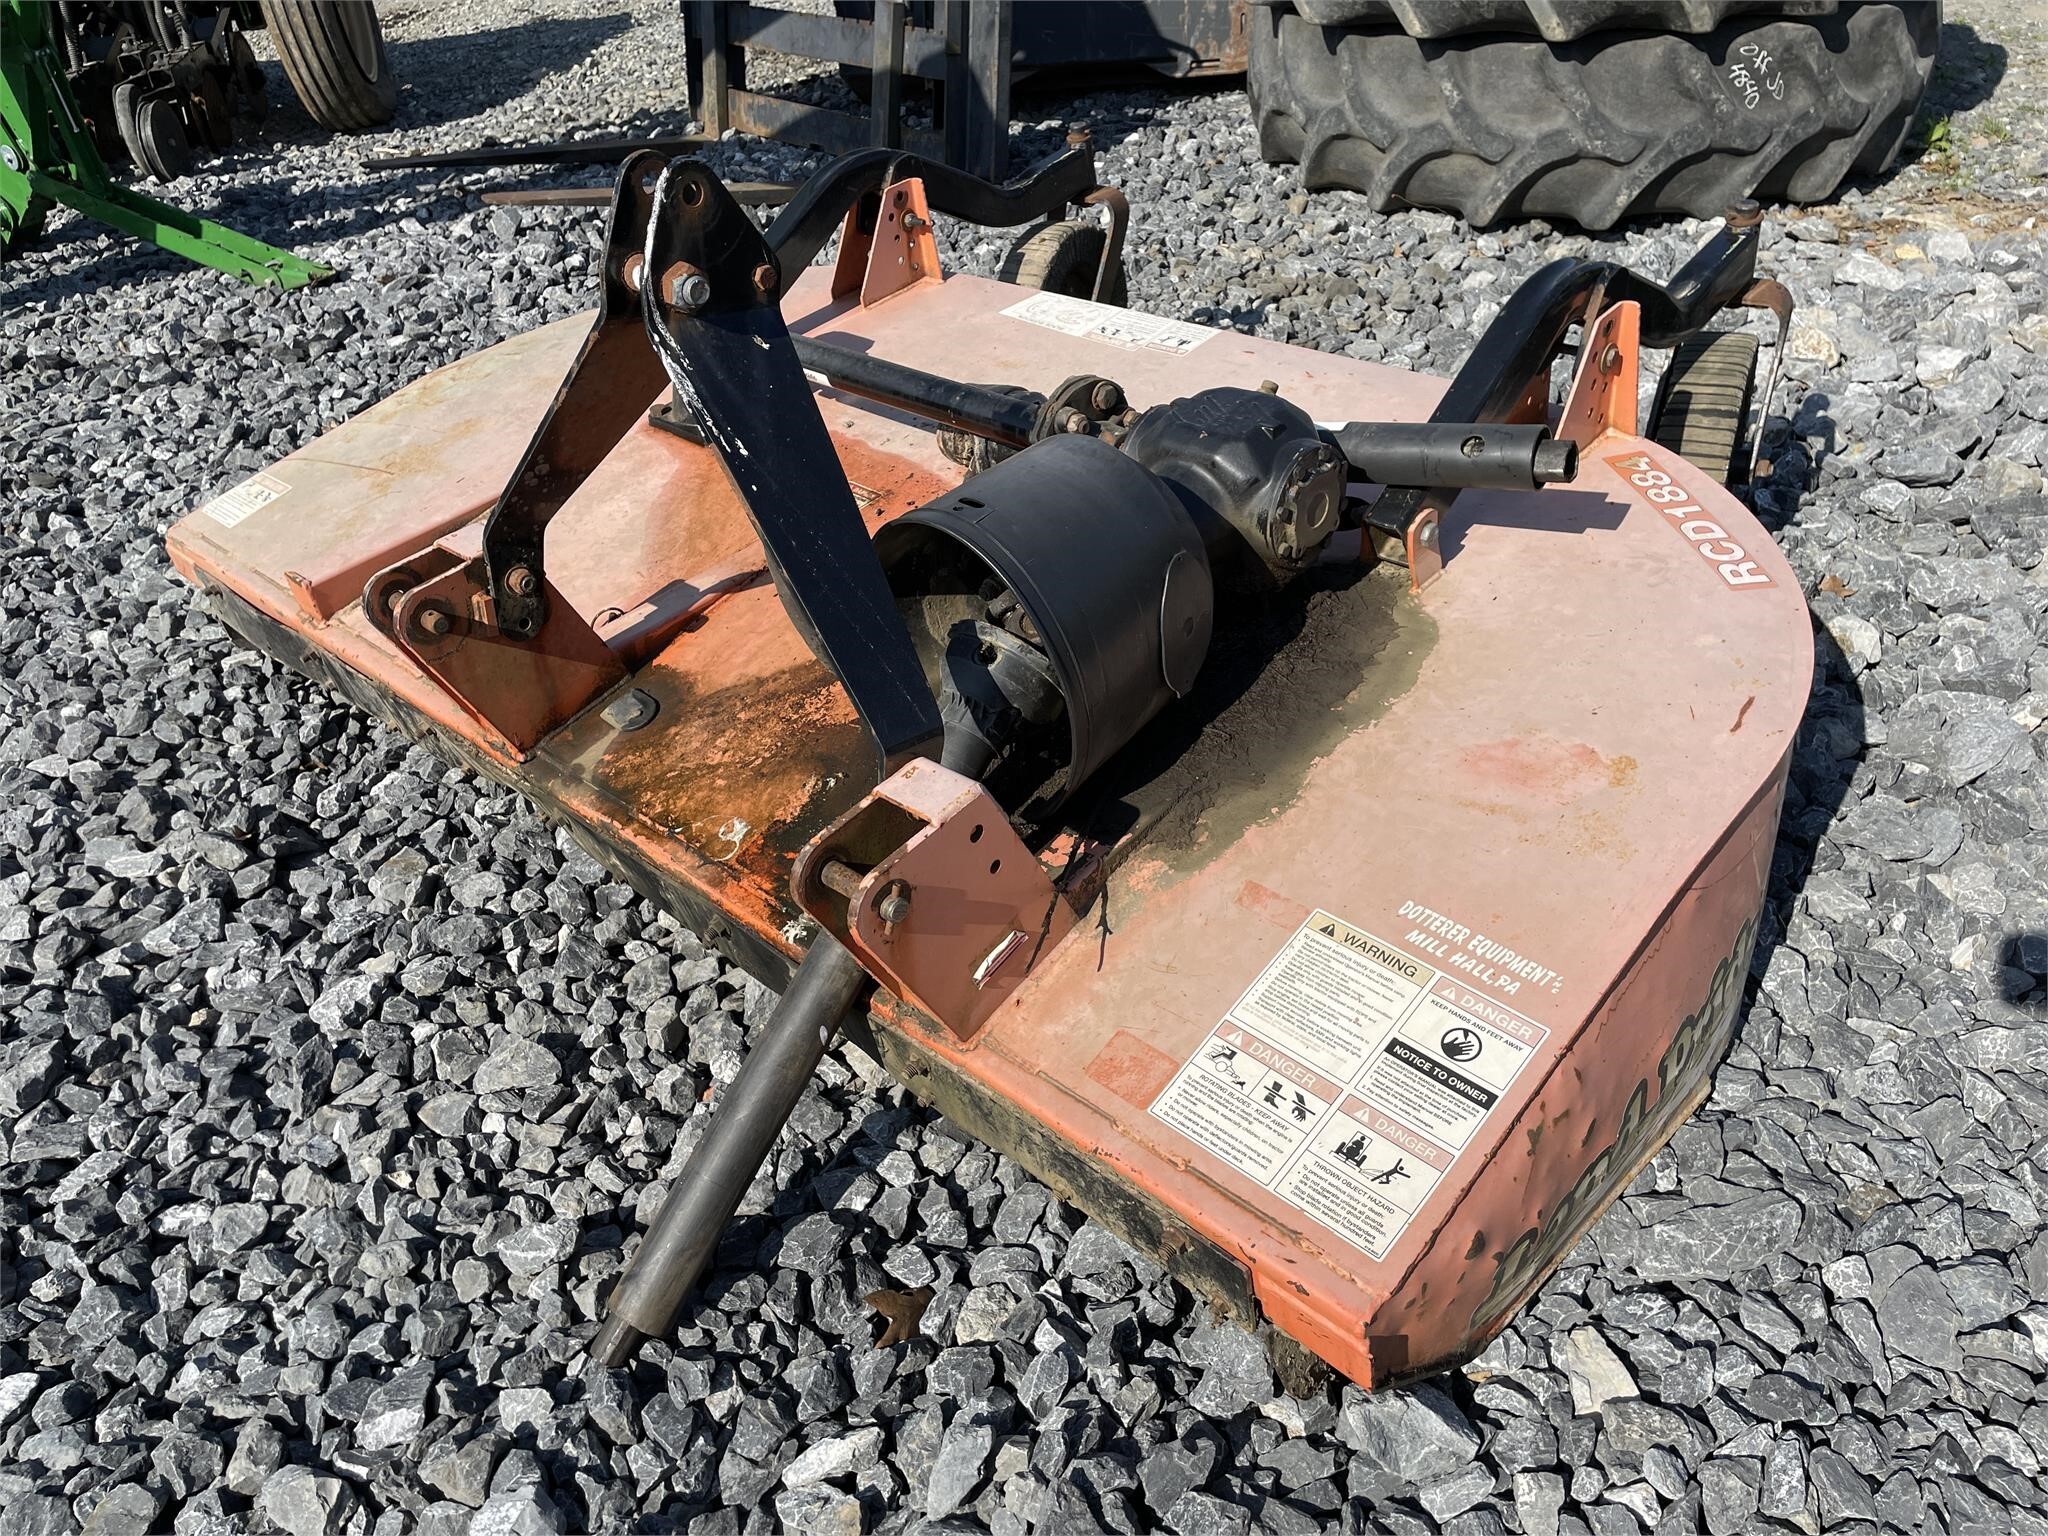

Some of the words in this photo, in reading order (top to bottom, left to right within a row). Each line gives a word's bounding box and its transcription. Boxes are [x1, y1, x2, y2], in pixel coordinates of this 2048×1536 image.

[1614, 456, 1772, 586] RCD1884
[1340, 931, 1419, 978] WARNING
[1398, 900, 1471, 946] DOTTERER
[1467, 934, 1557, 987] EQUIPMENT
[1404, 929, 1449, 958] MILL
[1429, 998, 1449, 1011] KEEP
[1447, 1008, 1472, 1024] HANDS
[1470, 1021, 1487, 1032] AND
[1485, 1029, 1503, 1041] FEET
[1502, 1038, 1523, 1052] AWAY
[1458, 994, 1534, 1040] DANGER
[1247, 1041, 1317, 1088] DANGER
[1392, 1044, 1433, 1071] NOTICE
[1430, 1066, 1449, 1081] TO
[1446, 1075, 1488, 1103] OWNER
[1198, 1073, 1228, 1094] ROTATING
[1226, 1090, 1252, 1109] BLADES
[1253, 1107, 1272, 1121] KEEP
[1269, 1117, 1290, 1132] AWAY
[1373, 1116, 1438, 1161] DANGER
[1312, 1160, 1342, 1181] THROWN
[1340, 1177, 1368, 1198] OBJECT
[1366, 1194, 1395, 1215] HAZARD
